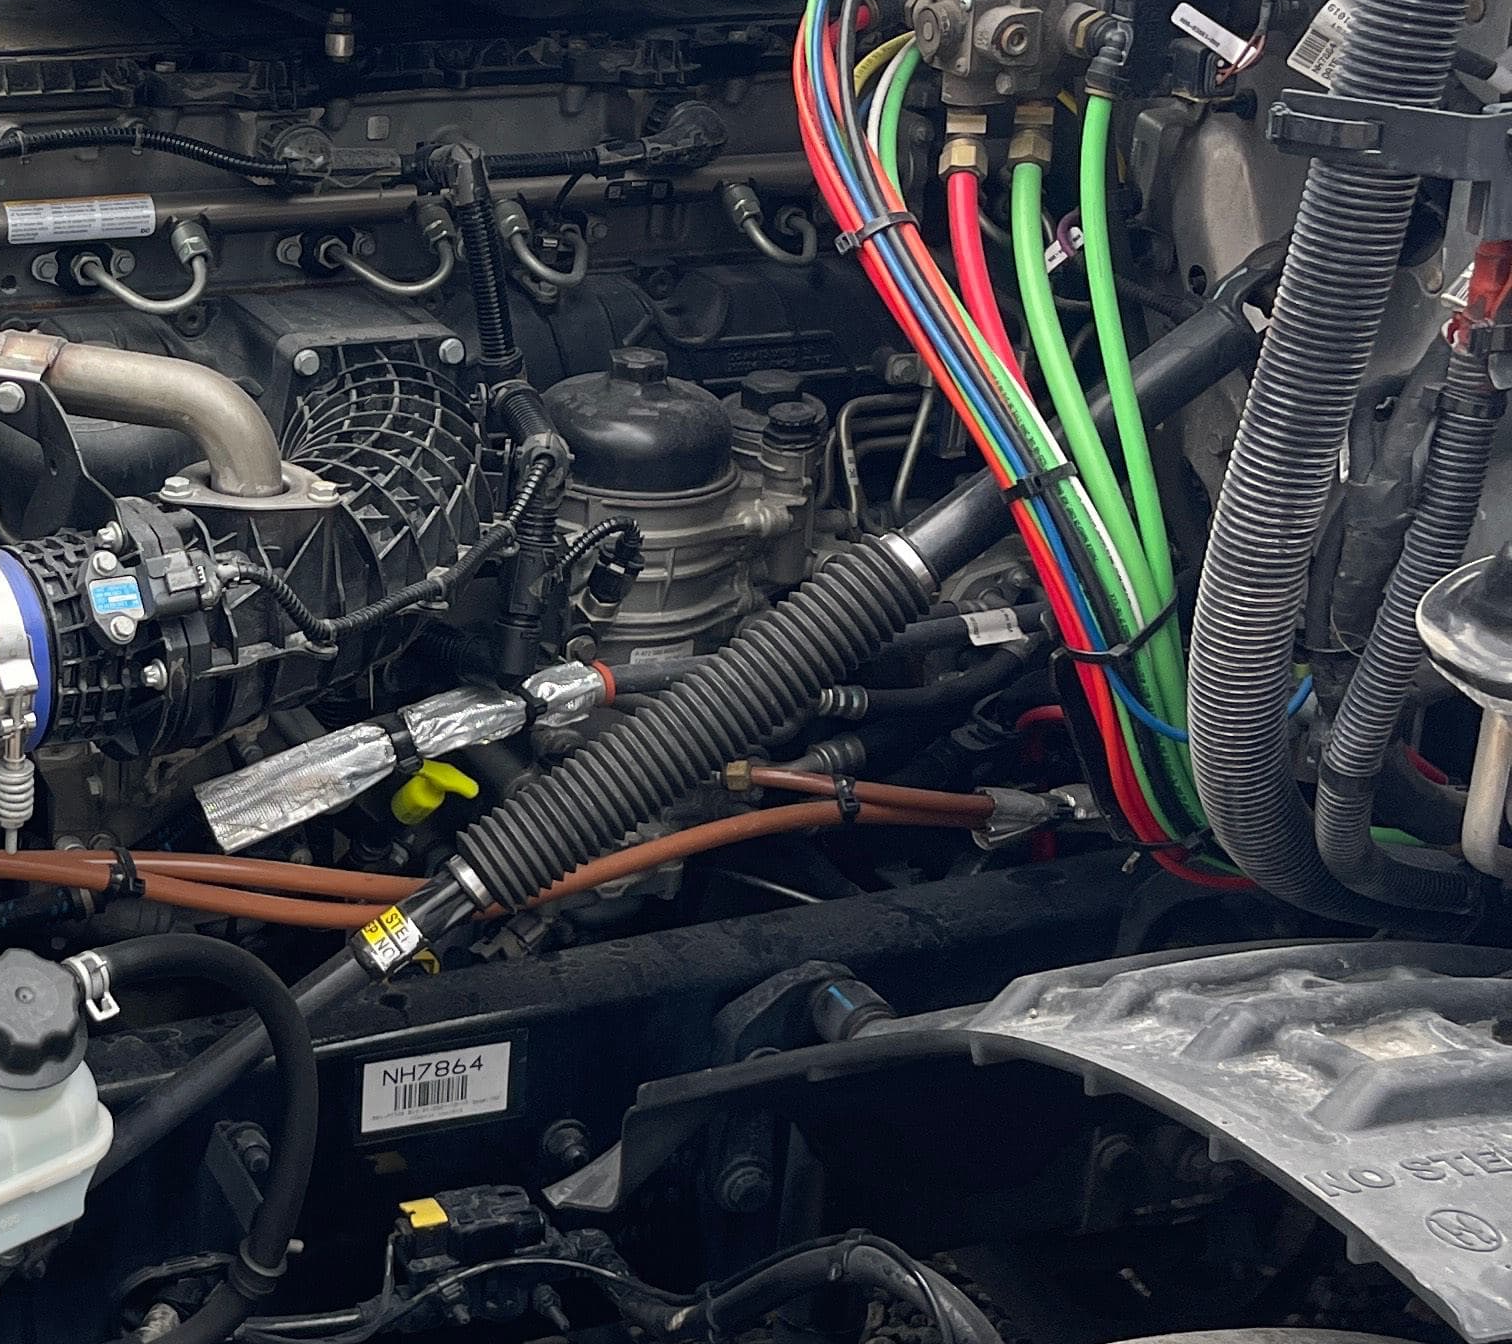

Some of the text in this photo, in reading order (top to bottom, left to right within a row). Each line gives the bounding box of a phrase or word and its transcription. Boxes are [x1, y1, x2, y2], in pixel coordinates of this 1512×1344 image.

[382, 1054, 484, 1086] NH7864
[1304, 1147, 1512, 1198] NO STE
